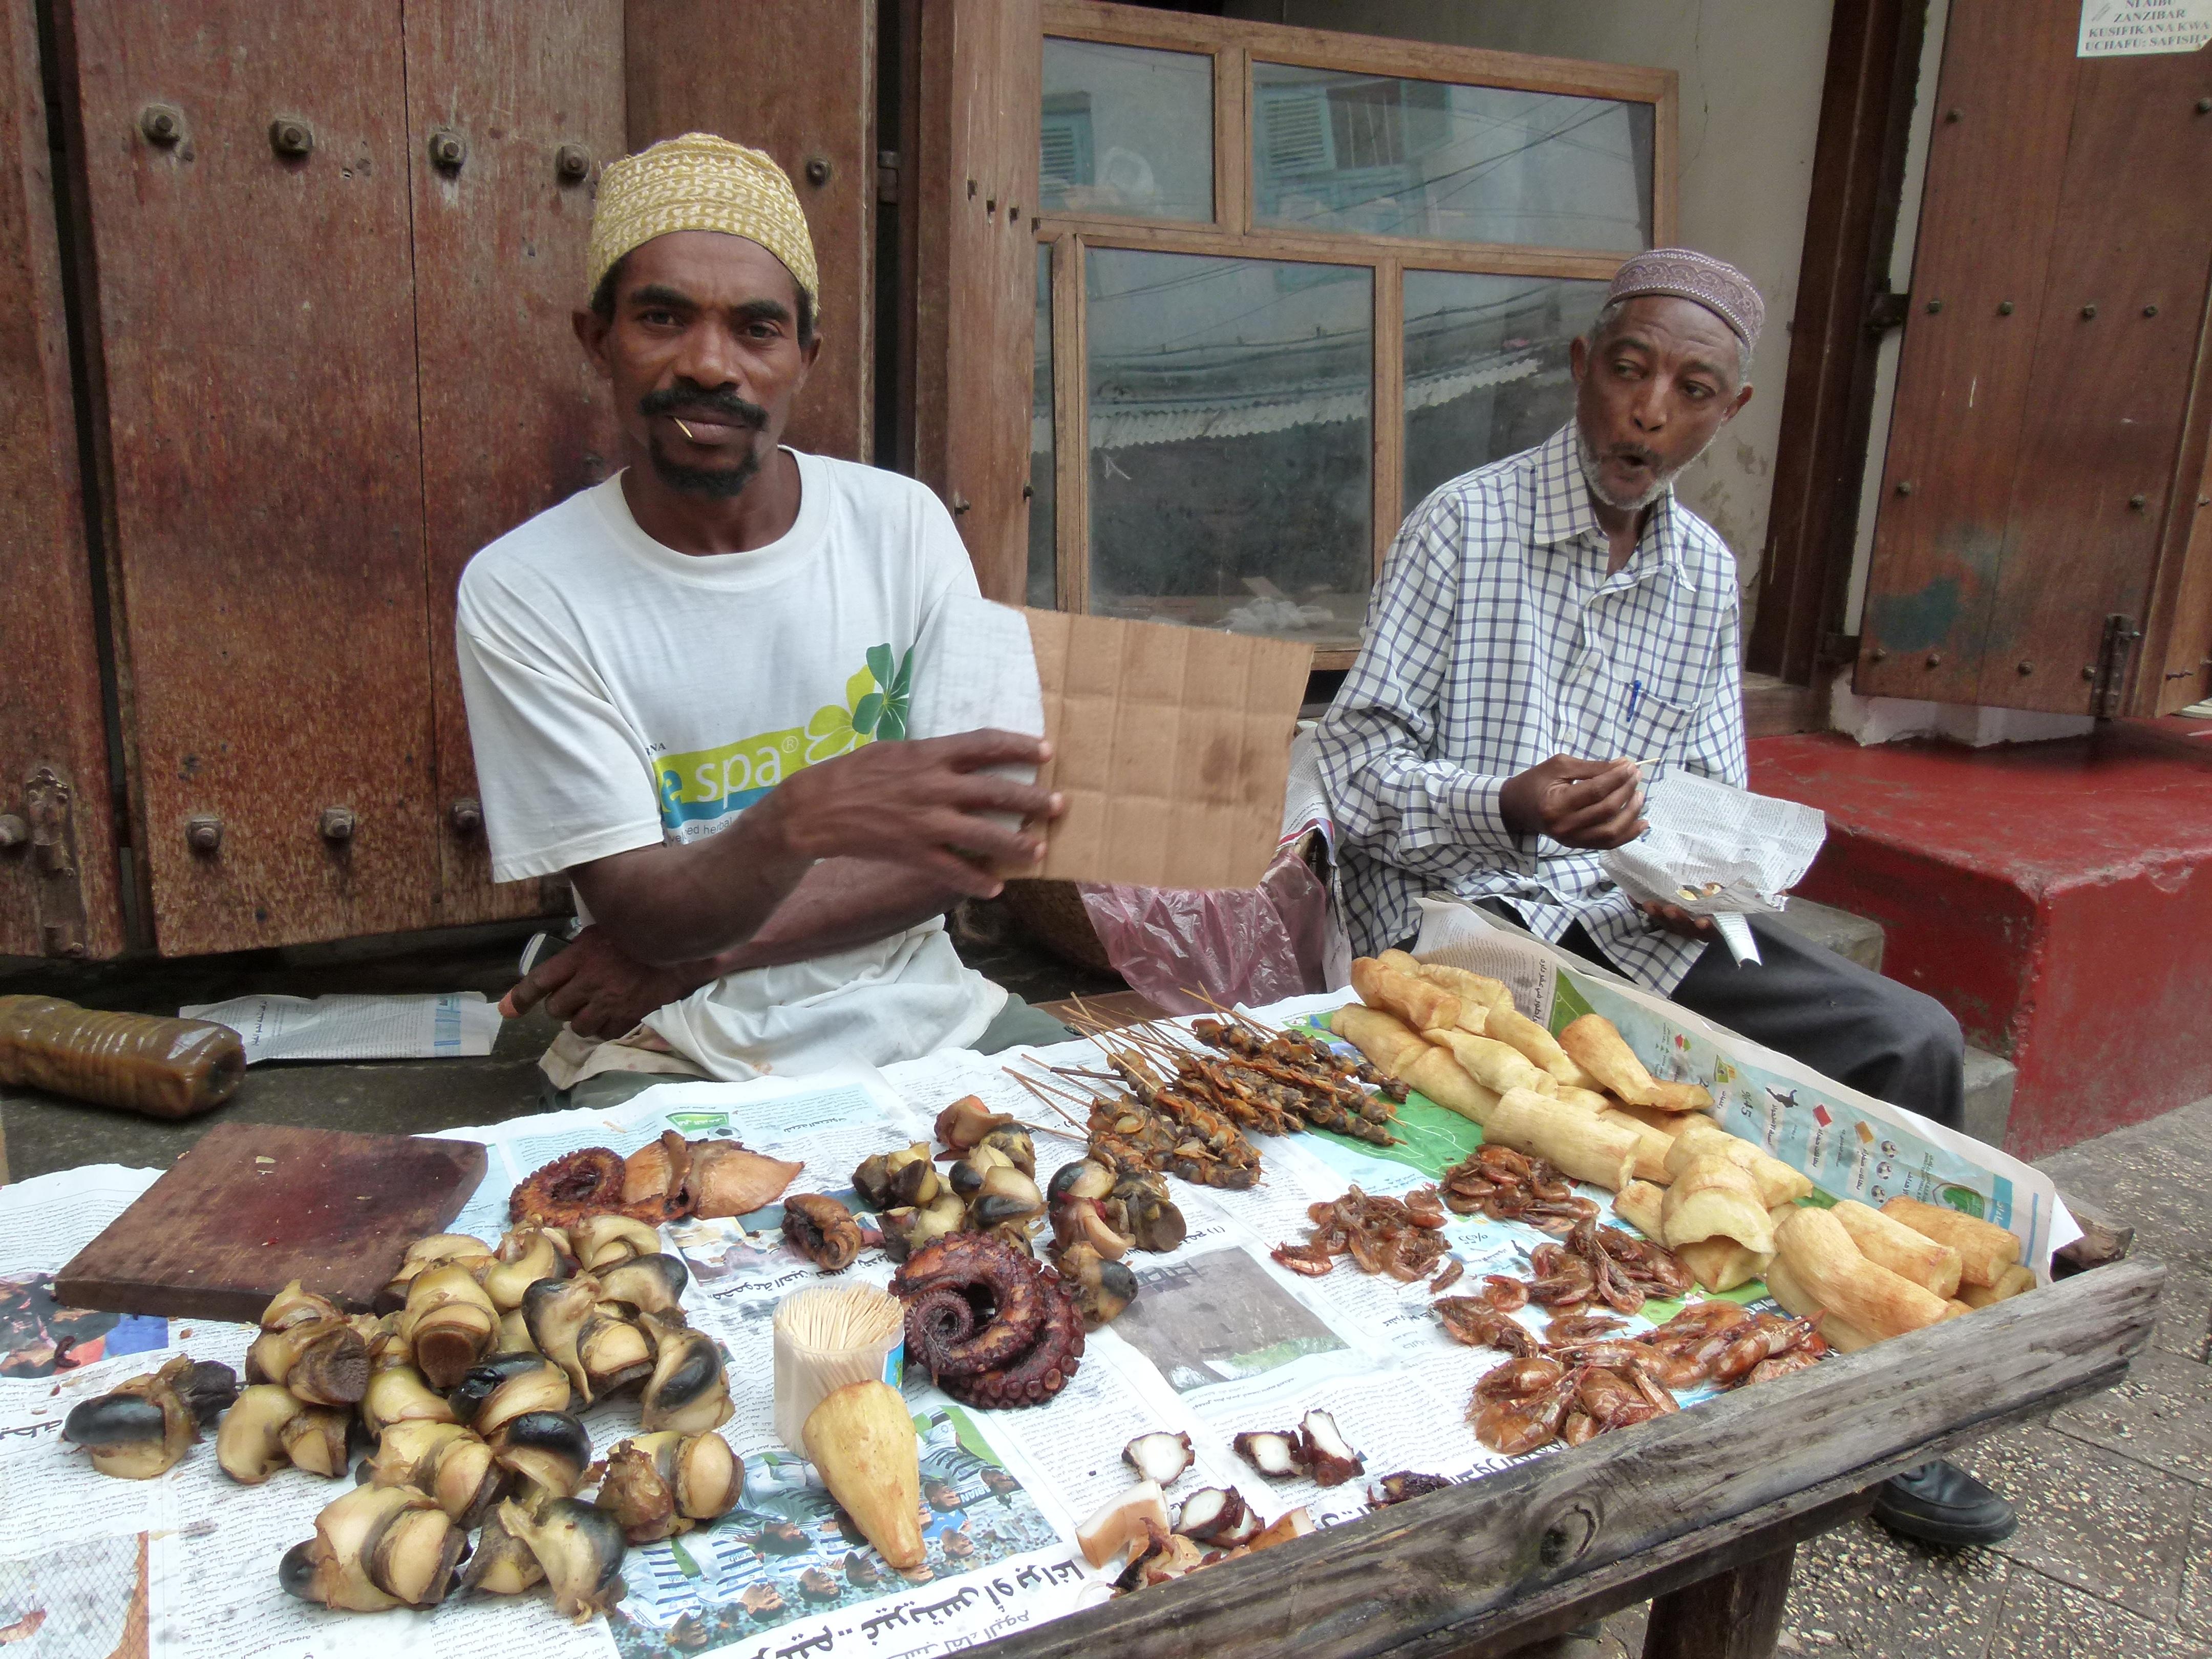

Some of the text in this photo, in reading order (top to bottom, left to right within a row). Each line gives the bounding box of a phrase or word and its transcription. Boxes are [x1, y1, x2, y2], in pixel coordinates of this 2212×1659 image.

[2113, 9, 2186, 23] ZANZIBAR
[2178, 20, 2210, 31] KWA
[704, 817, 732, 835] herbal
[861, 1587, 979, 1646] غيريتس
[984, 1578, 1015, 1613] أو
[1016, 1559, 1086, 1589] براغا
[985, 1610, 1030, 1639] اليوم
